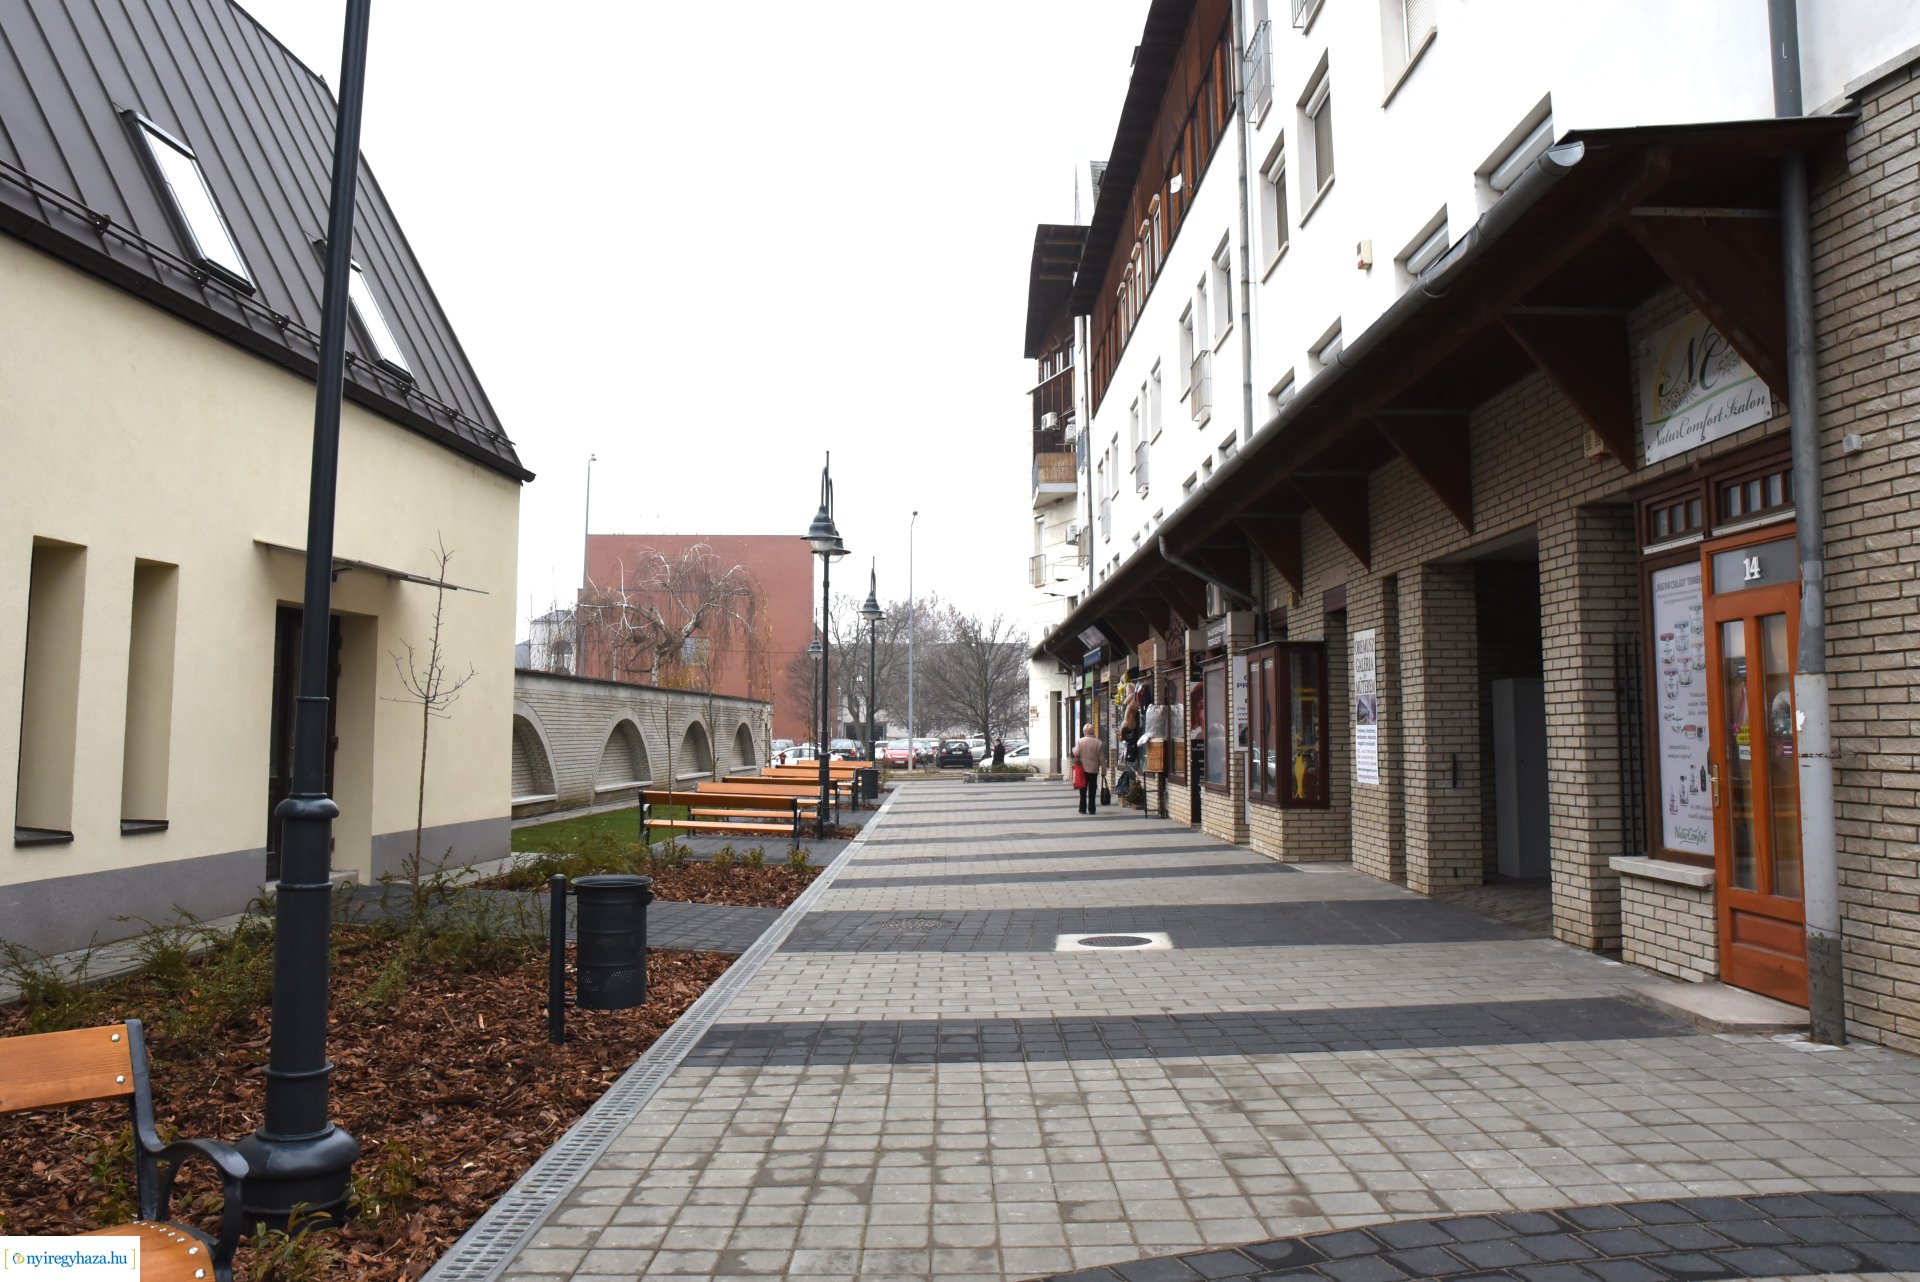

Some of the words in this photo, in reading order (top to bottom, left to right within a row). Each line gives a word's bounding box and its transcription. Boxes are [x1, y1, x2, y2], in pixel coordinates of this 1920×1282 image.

[1724, 388, 1766, 419] Szalon
[1743, 556, 1761, 580] 14
[1356, 655, 1375, 672] GALÉRIA
